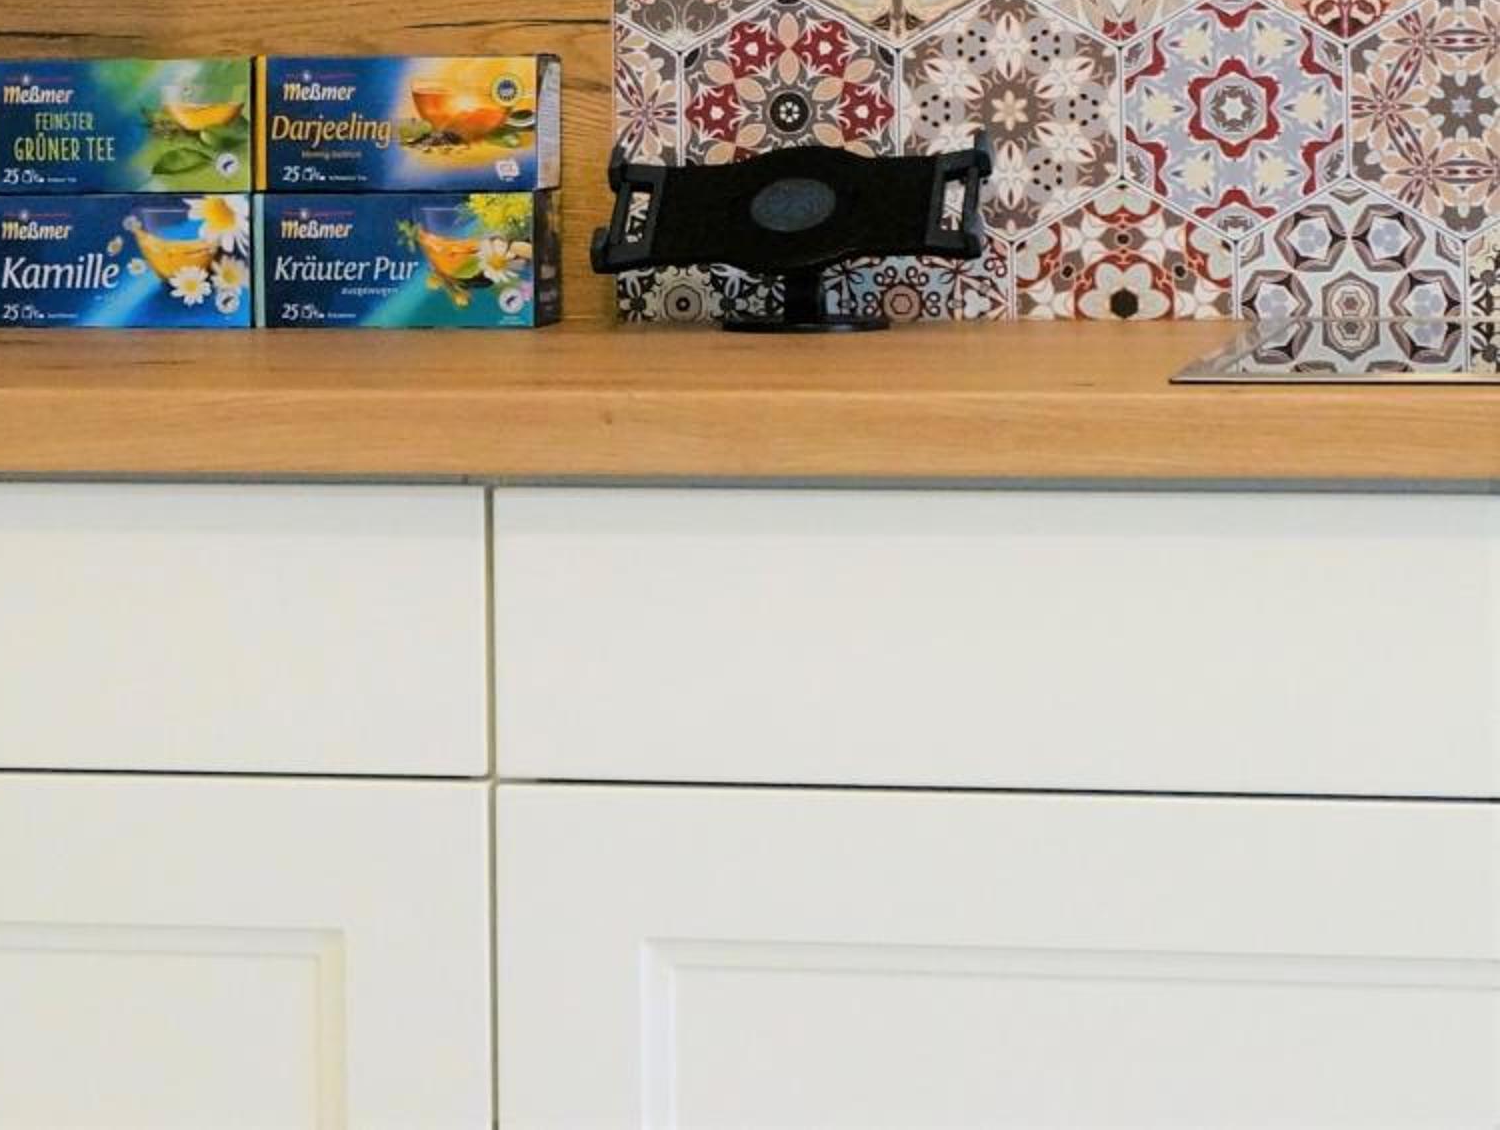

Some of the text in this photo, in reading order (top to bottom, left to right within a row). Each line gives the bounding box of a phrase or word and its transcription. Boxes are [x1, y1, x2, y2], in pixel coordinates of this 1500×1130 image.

[3, 85, 74, 104] Meßmer
[283, 83, 356, 101] Meßmer
[35, 111, 94, 131] FEINSTER
[271, 114, 392, 149] Darjeeling
[13, 133, 116, 161] GRÜNER TEE
[3, 168, 20, 184] 25
[282, 165, 300, 182] 25
[1, 221, 72, 240] Meßmer
[281, 220, 353, 239] Meßmer
[1, 253, 120, 289] Kamille
[275, 256, 418, 281] Kräuter Pur
[3, 303, 20, 321] 25
[281, 303, 299, 320] 25
